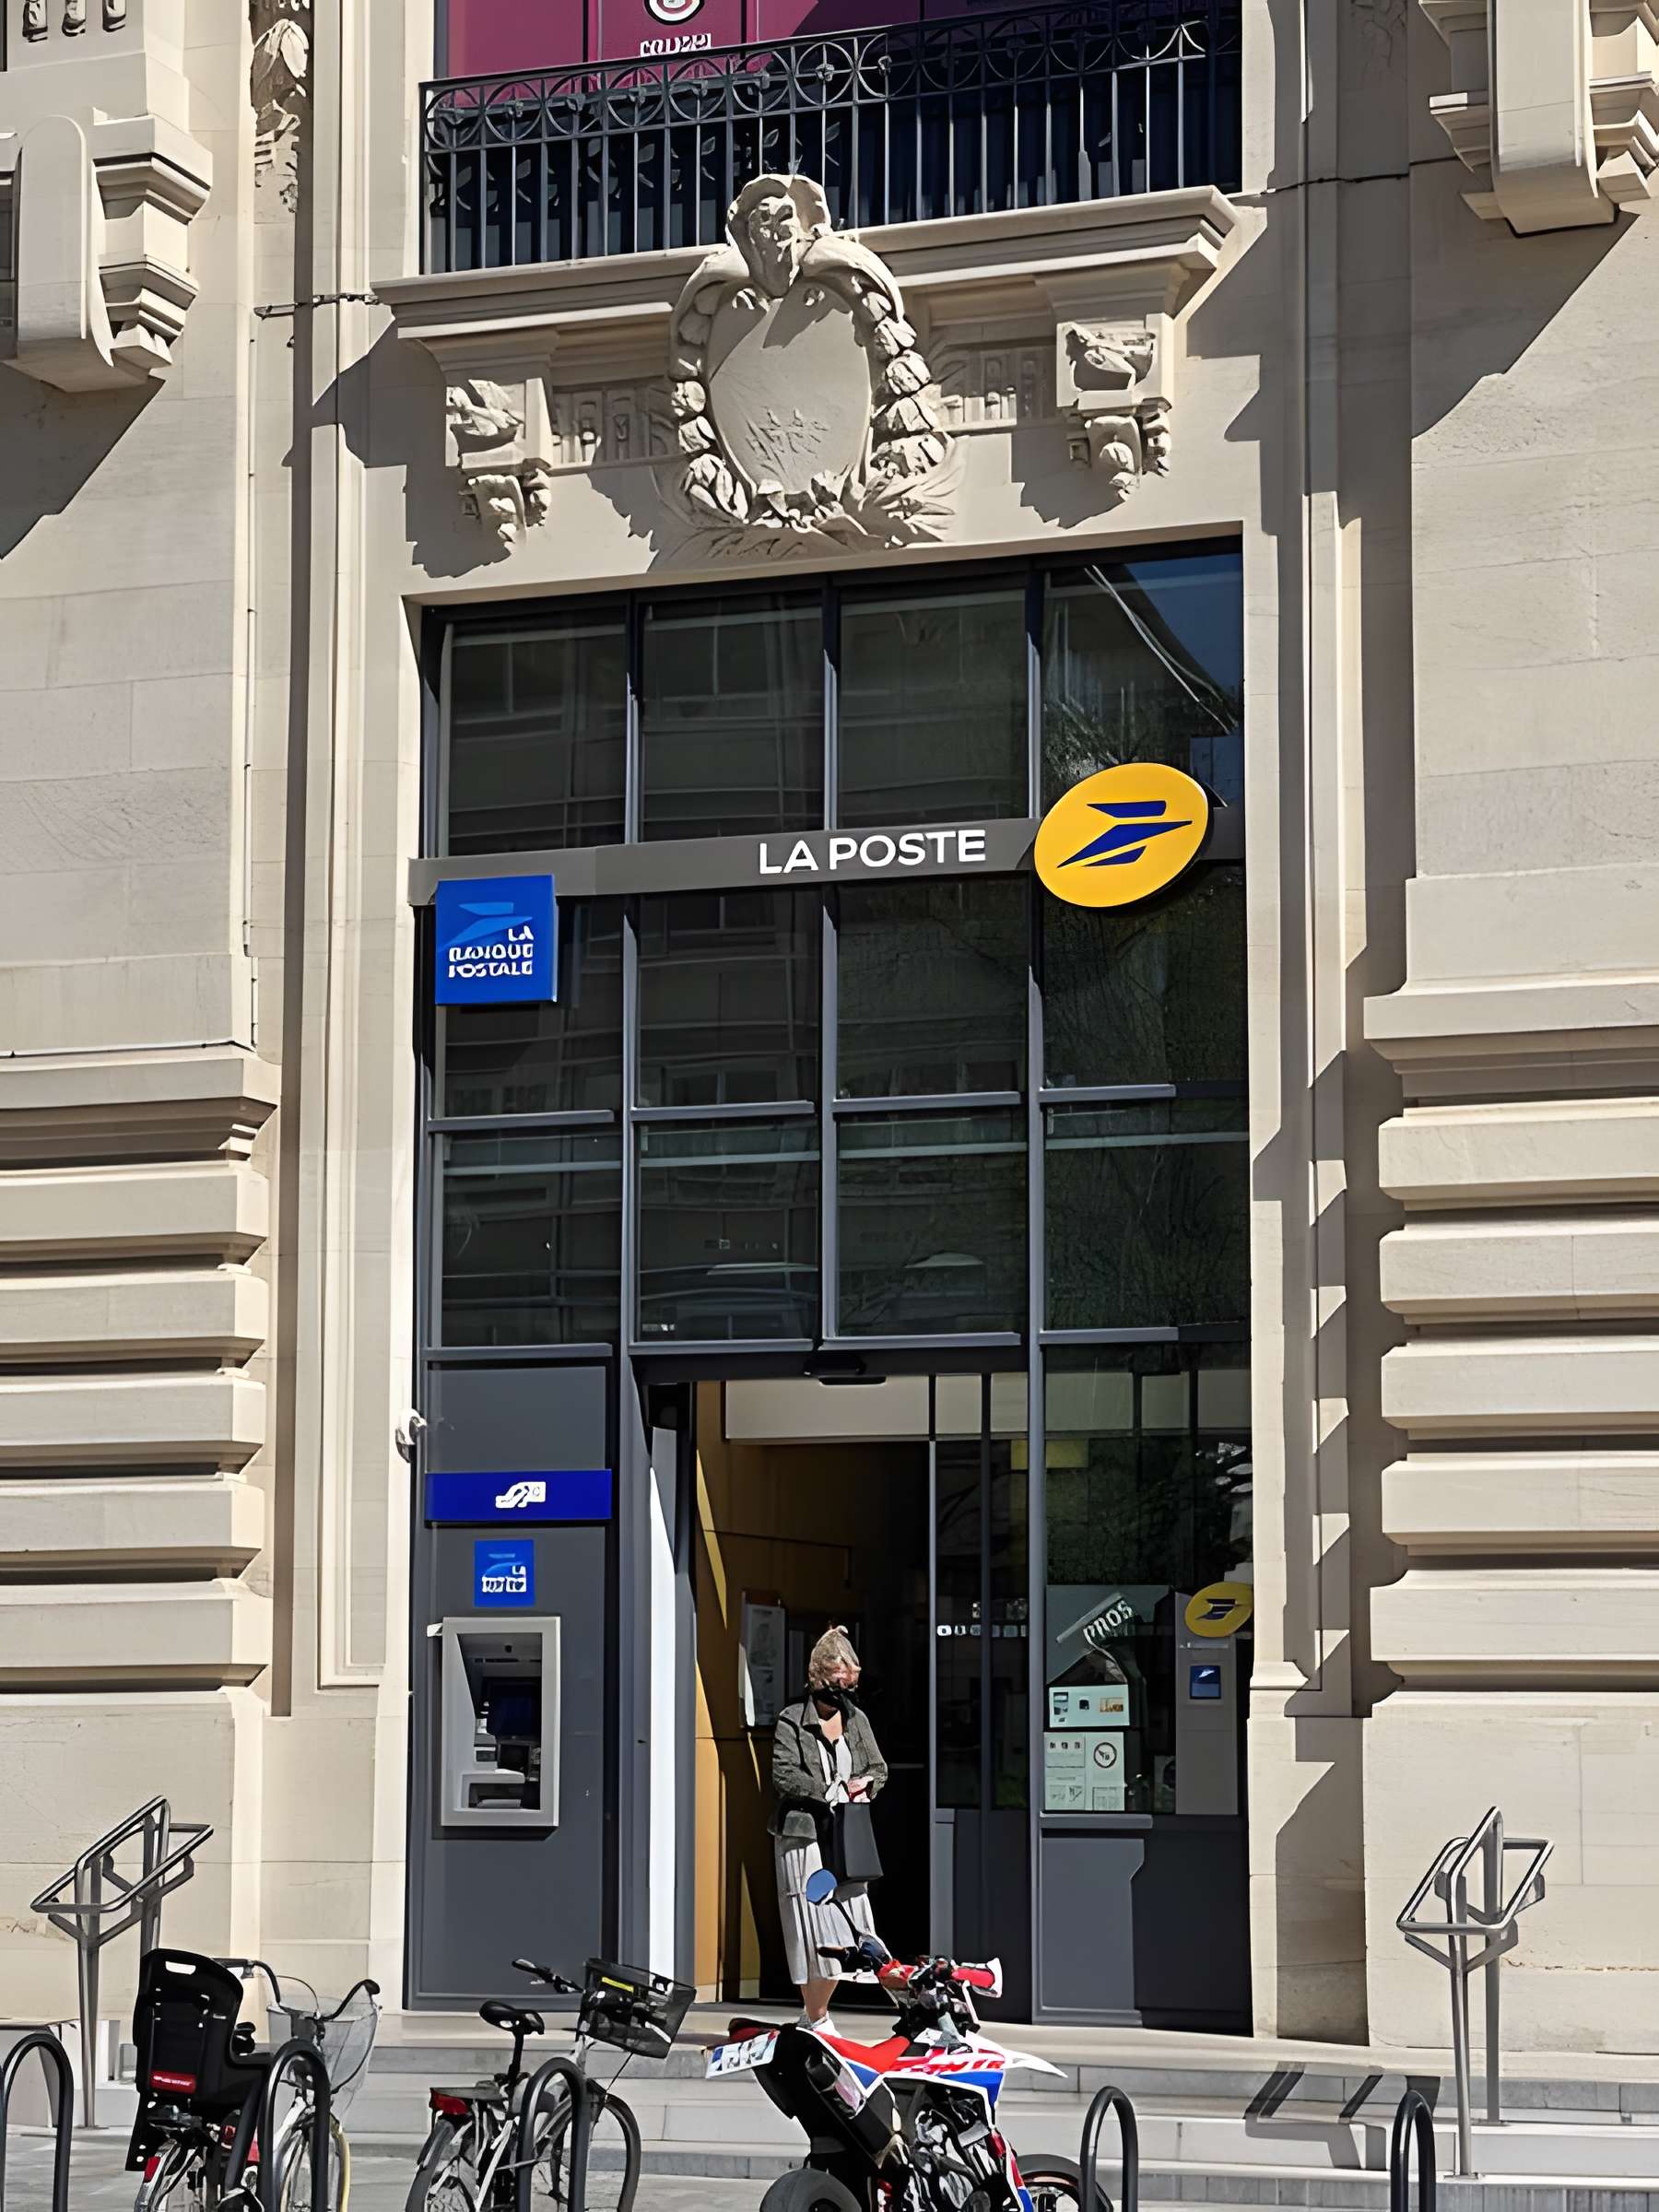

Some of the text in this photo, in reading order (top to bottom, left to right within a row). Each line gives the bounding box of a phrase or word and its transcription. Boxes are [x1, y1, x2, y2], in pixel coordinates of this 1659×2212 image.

[759, 830, 986, 875] LA POSTE
[508, 924, 534, 941] LA
